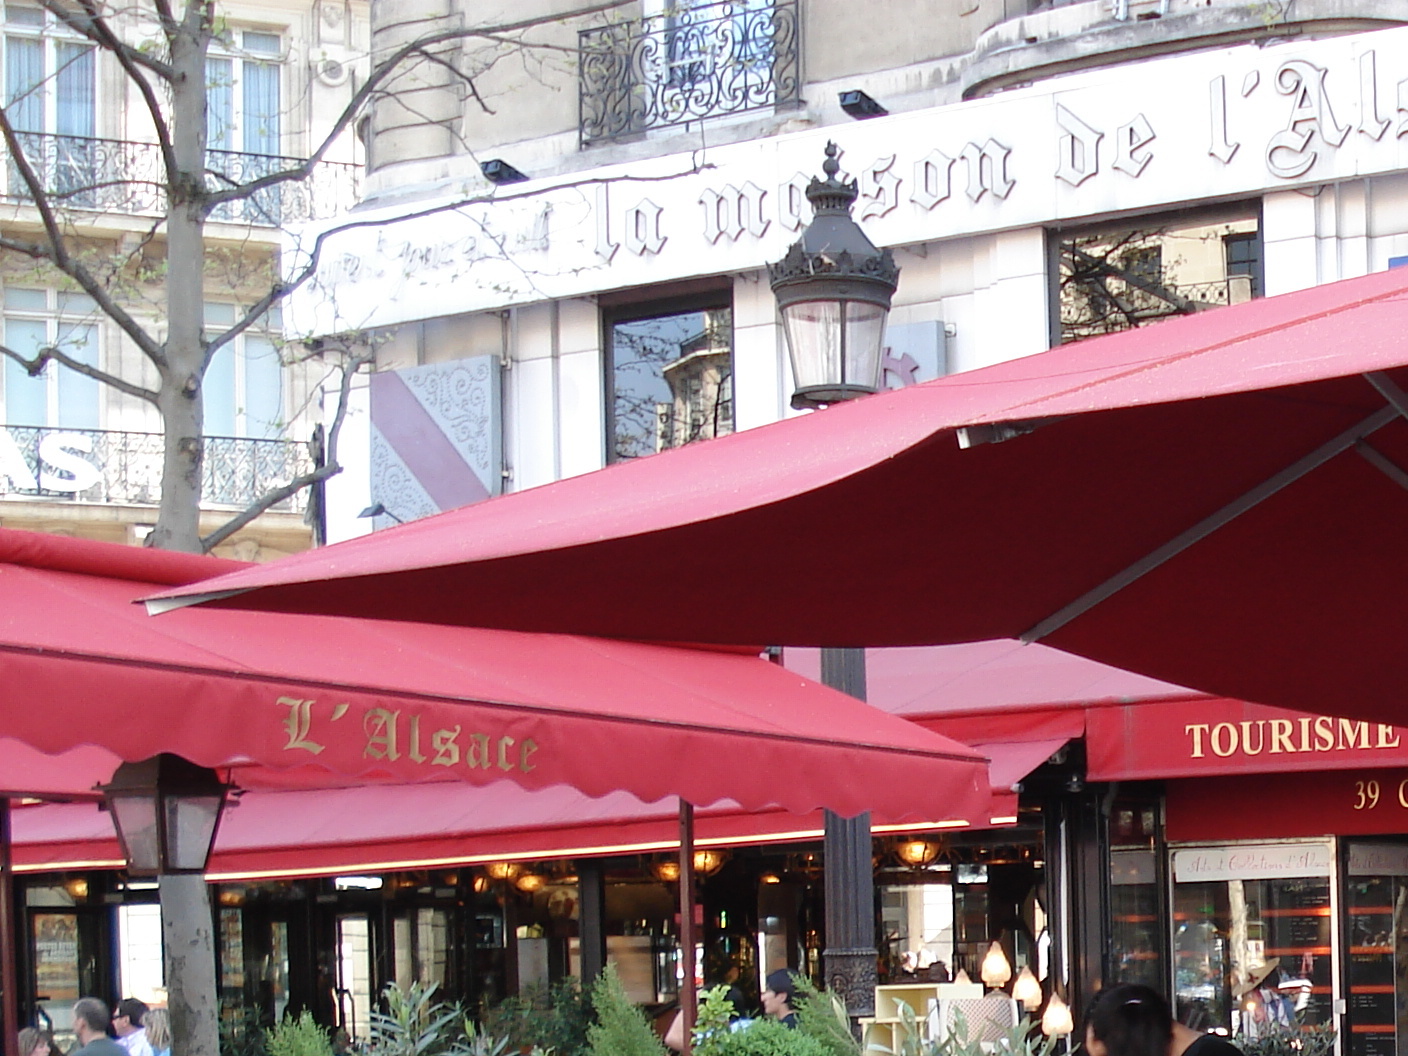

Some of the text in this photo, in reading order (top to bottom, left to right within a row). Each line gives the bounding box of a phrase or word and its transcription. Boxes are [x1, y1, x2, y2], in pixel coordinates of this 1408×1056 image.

[594, 182, 668, 262] la
[698, 137, 1016, 246] mason
[1055, 102, 1157, 187] de
[276, 696, 539, 773] L'Alsace
[1185, 715, 1400, 758] TOURISME
[1353, 780, 1380, 810] 39
